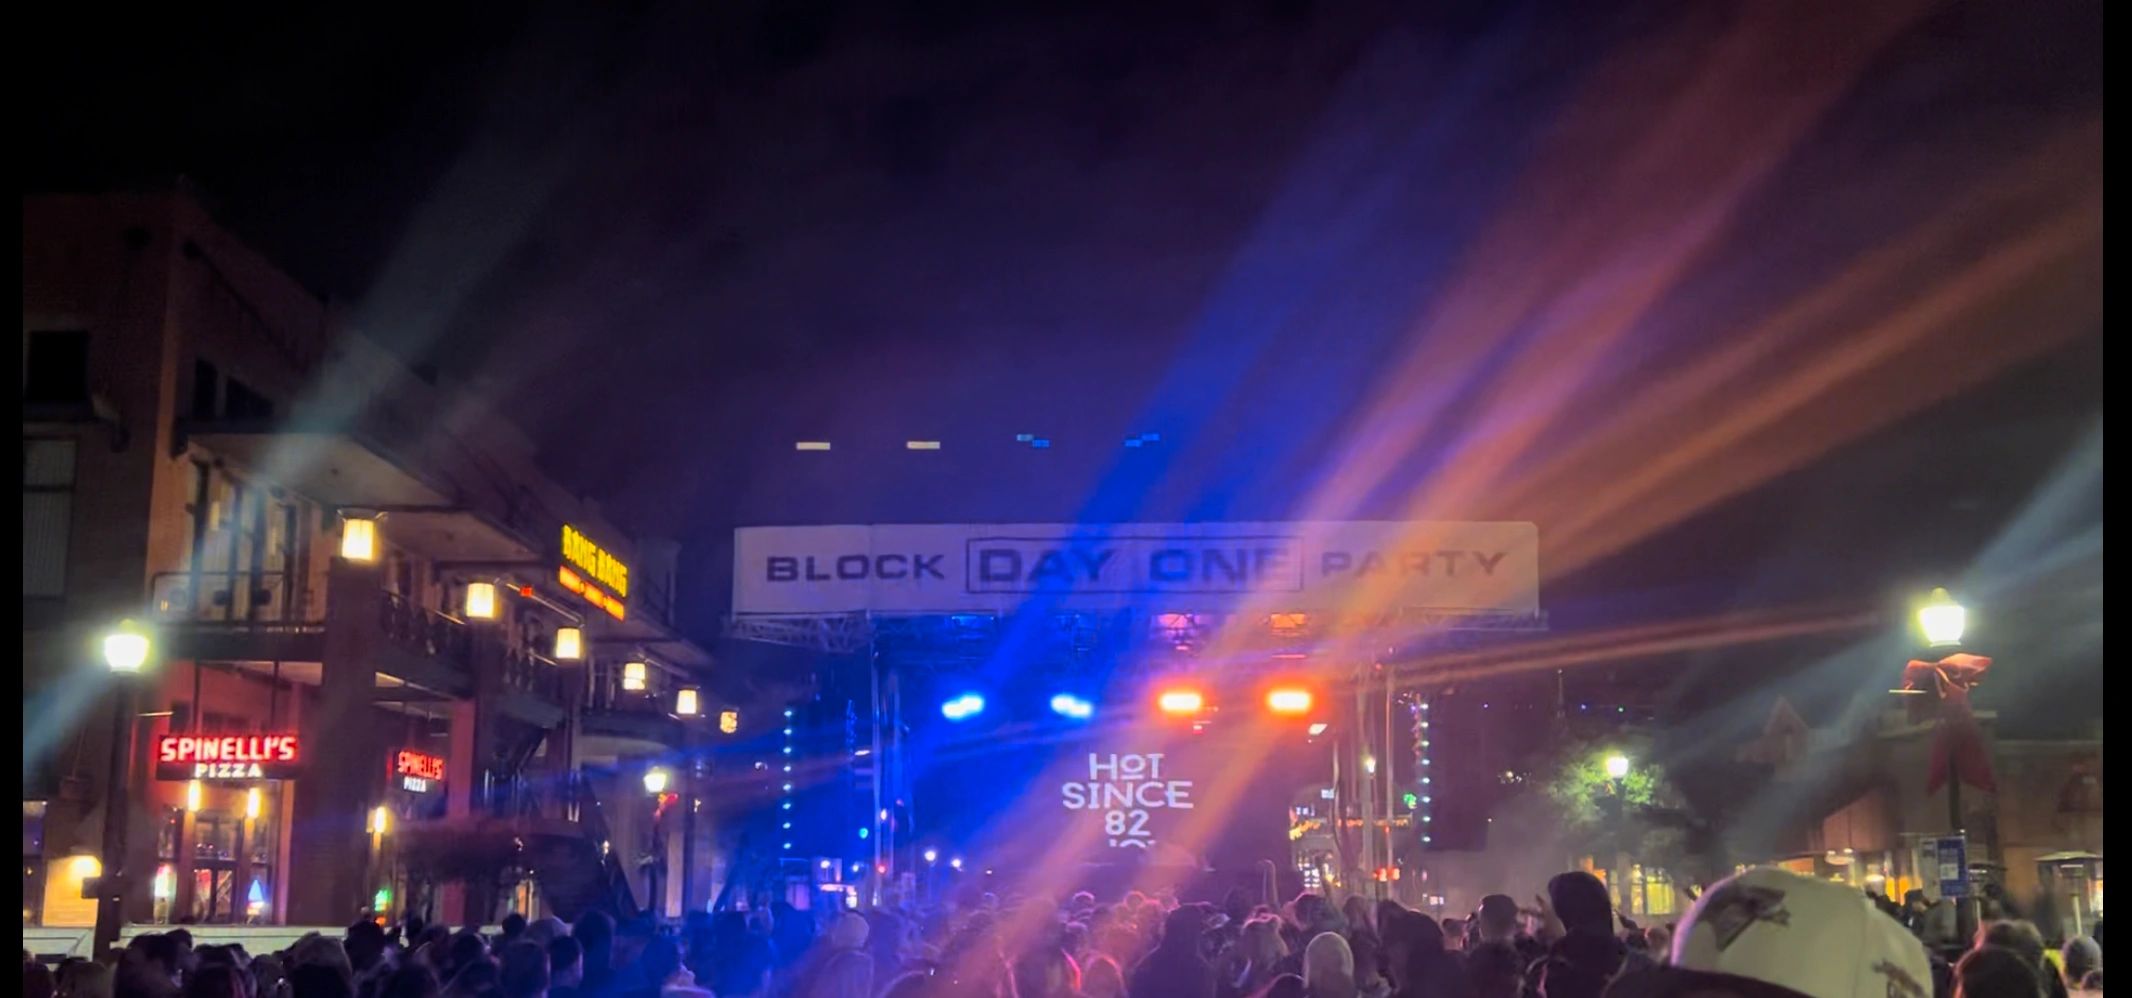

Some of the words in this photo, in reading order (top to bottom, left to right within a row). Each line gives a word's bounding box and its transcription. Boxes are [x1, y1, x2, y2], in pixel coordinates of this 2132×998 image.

[766, 553, 945, 582] BLOCK
[979, 548, 1114, 582] DAY
[1150, 548, 1289, 585] ONE
[1321, 550, 1509, 578] PARTY
[160, 736, 296, 762] SPINELLI'S
[194, 762, 263, 778] PIZZA
[1089, 752, 1165, 781] HOT
[1061, 780, 1194, 810] SINCE
[1104, 808, 1152, 836] 82
